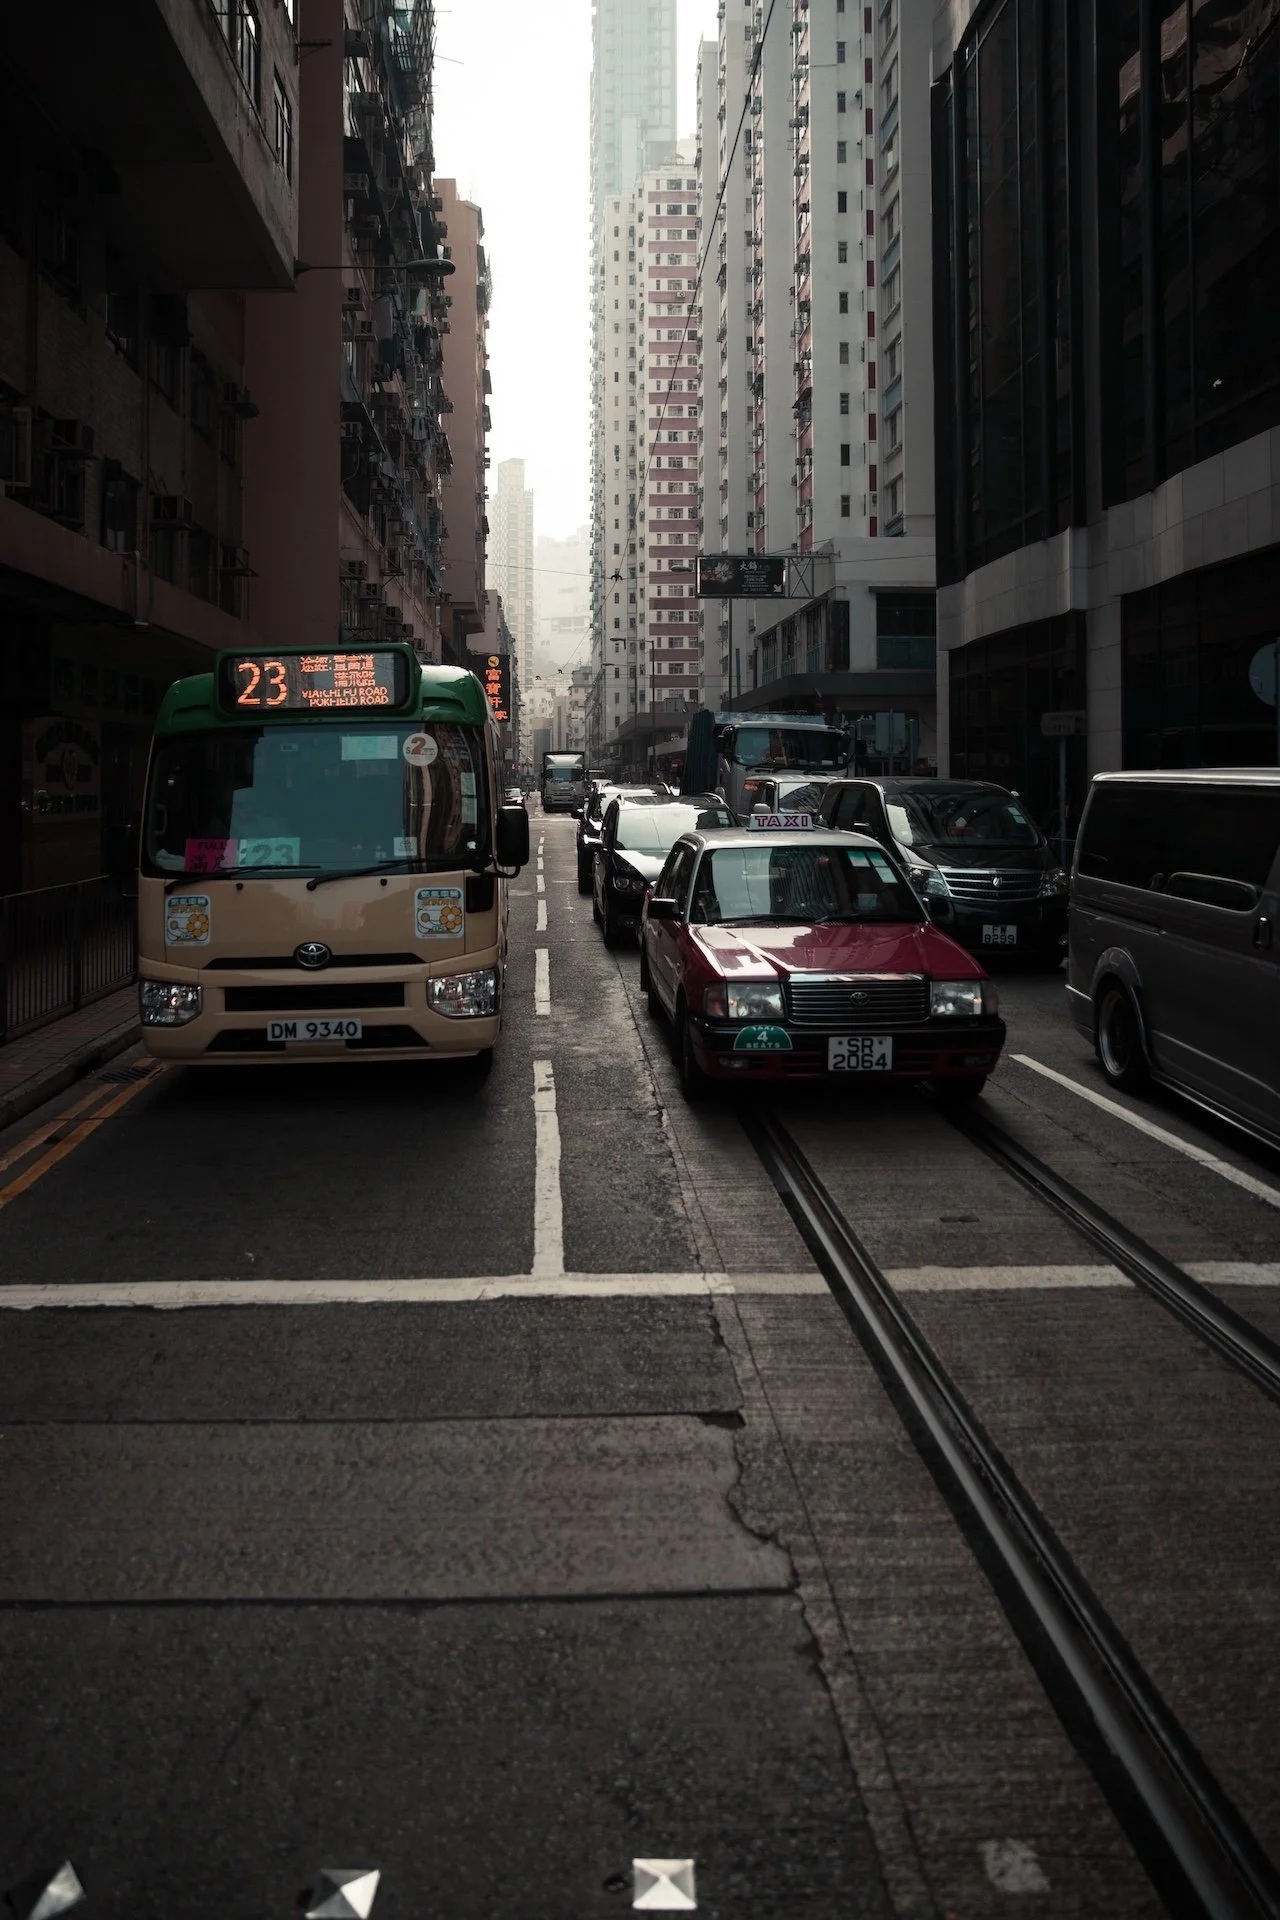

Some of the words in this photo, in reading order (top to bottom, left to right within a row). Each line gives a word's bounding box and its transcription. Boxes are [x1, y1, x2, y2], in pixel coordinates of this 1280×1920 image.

[237, 661, 288, 707] 23
[359, 686, 388, 696] ROAD
[359, 695, 389, 705] ROAD
[755, 815, 808, 827] TAXI
[197, 841, 227, 850] FULL
[252, 844, 294, 865] 23
[271, 1022, 297, 1039] DM
[306, 1021, 358, 1038] 9340
[757, 1030, 768, 1042] 4
[847, 1038, 874, 1054] SR
[833, 1053, 887, 1069] 2064
